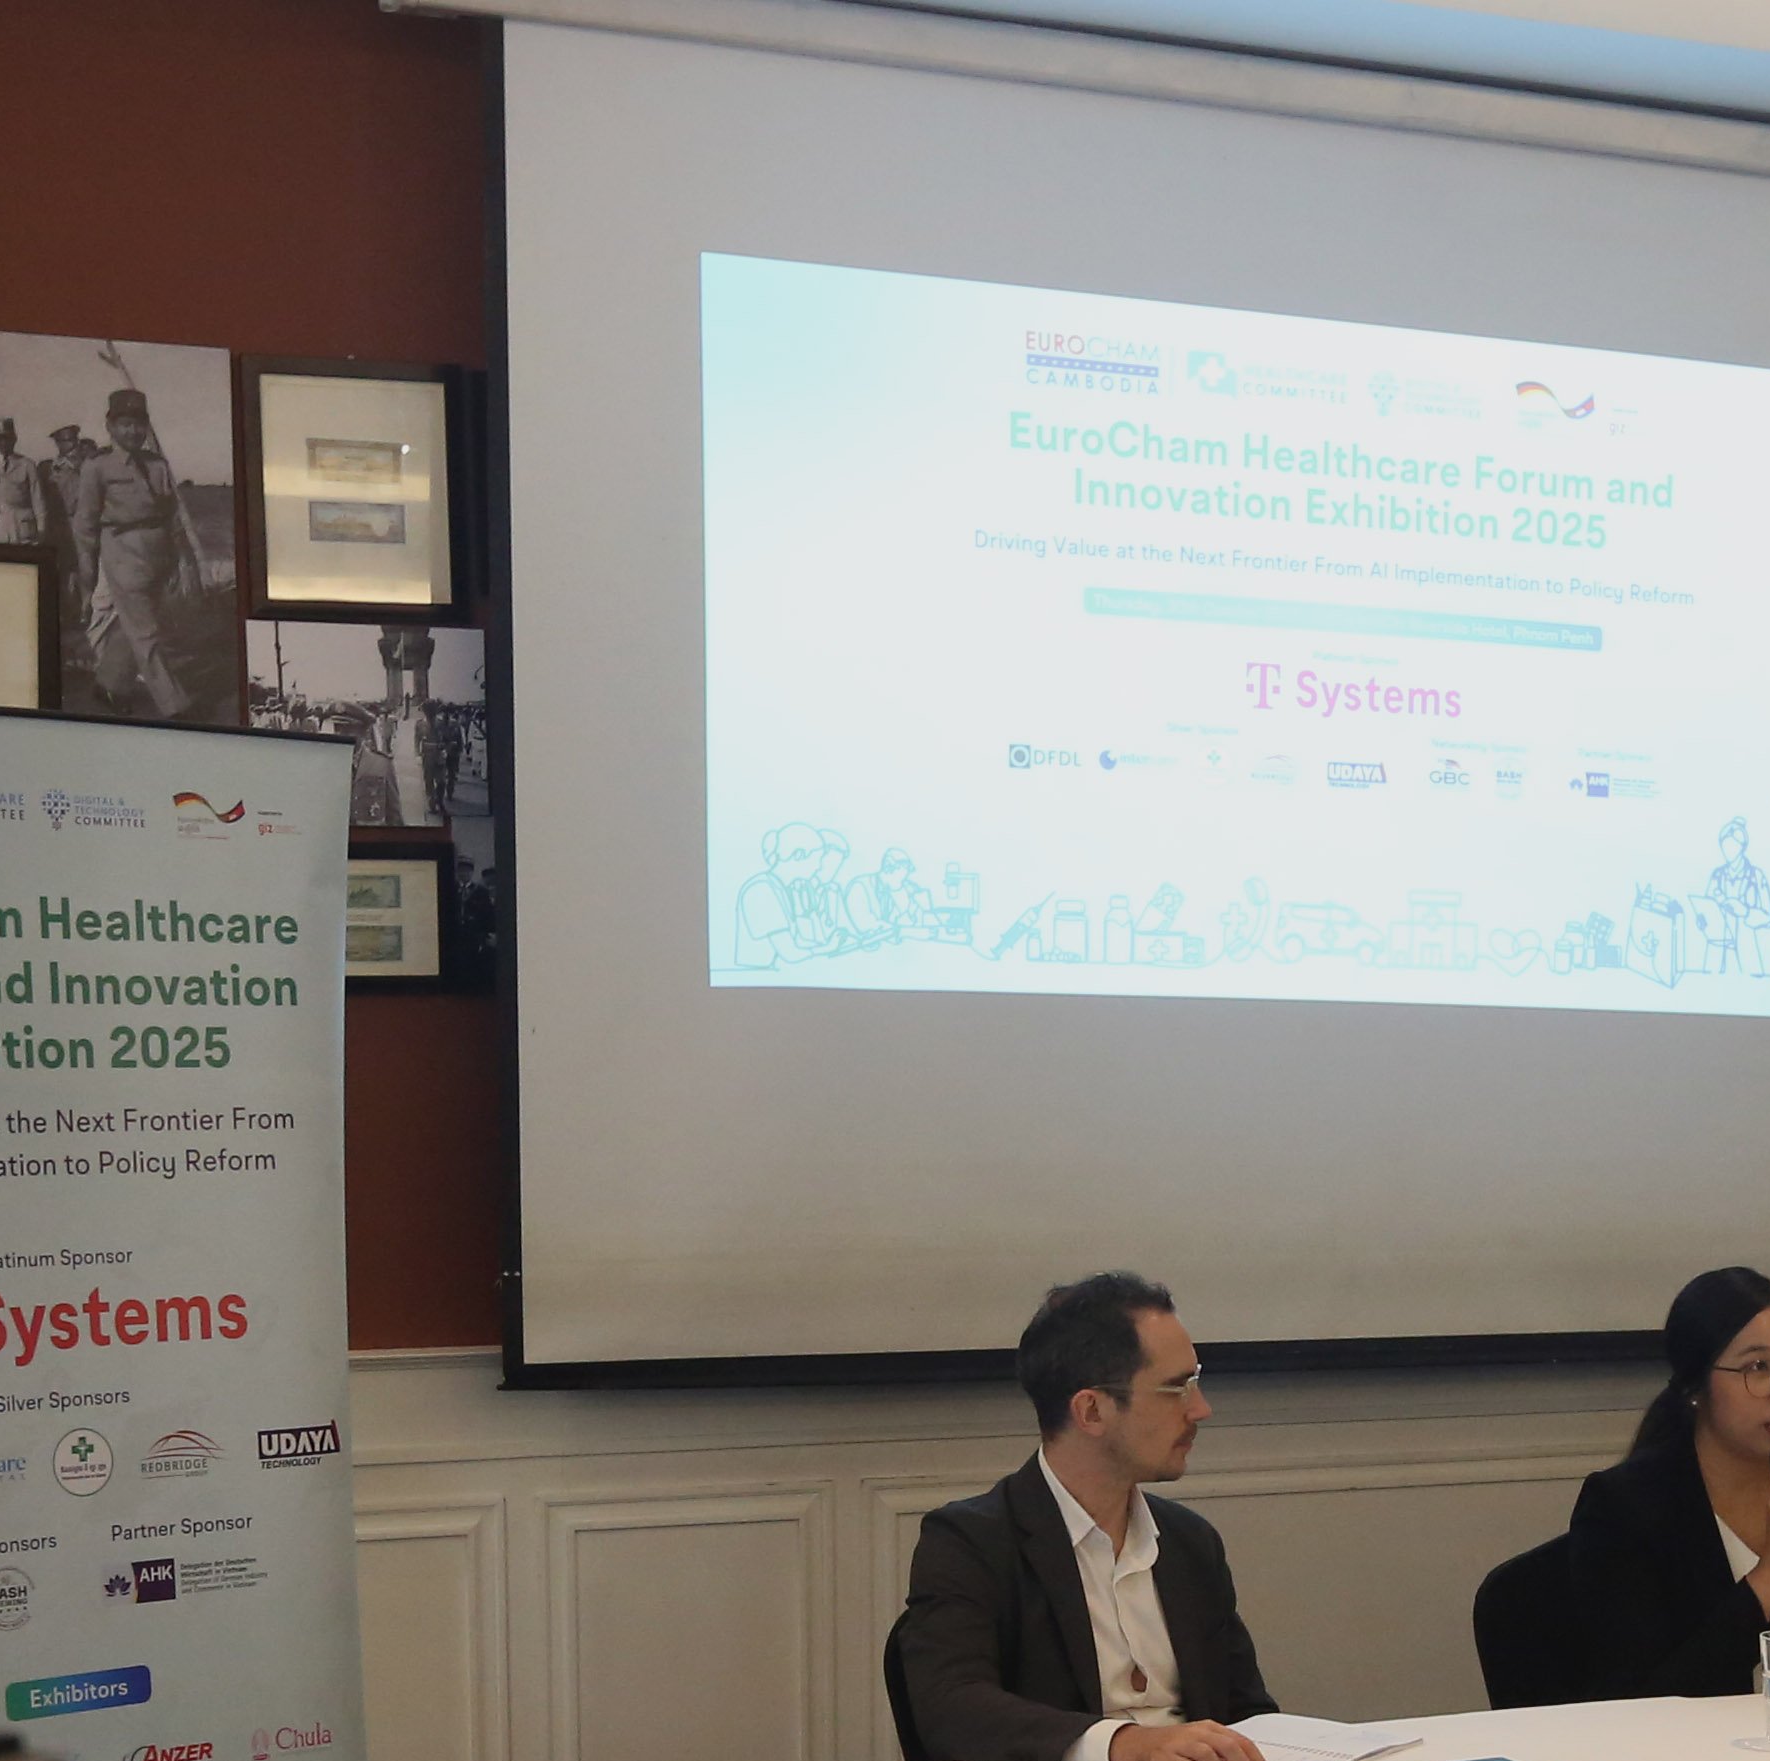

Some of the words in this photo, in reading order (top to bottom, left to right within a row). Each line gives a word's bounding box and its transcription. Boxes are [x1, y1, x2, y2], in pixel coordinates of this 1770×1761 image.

[1026, 330, 1159, 361] EUROCHAM
[1027, 368, 1158, 395] CAMBODIA
[1243, 382, 1347, 404] COMMITTEE
[1009, 411, 1228, 468] EuroCham
[1243, 433, 1460, 489] Healthcare
[1475, 456, 1592, 501] Forum
[1606, 474, 1673, 510] and
[1074, 468, 1291, 523] Innovation
[1307, 489, 1498, 542] Exhibition
[1511, 508, 1606, 550] 2025
[975, 529, 1046, 558] Driving
[1053, 536, 1110, 558] Value
[1117, 544, 1134, 560] at
[1141, 544, 1173, 563] the
[1180, 546, 1226, 567] Next
[1232, 549, 1308, 574] Frontier
[1314, 556, 1363, 577] From
[1370, 562, 1387, 579] AI
[1395, 564, 1540, 593] Implementation
[1546, 578, 1563, 595] to
[1569, 578, 1623, 604] Policy
[1630, 584, 1694, 606] Reform
[1561, 628, 1594, 646] Penh
[1295, 669, 1462, 718] Systems
[1033, 750, 1081, 768] DFDL
[1329, 763, 1383, 783] UDAYA
[1430, 770, 1470, 786] GBC
[74, 796, 114, 806] DIGITAL
[75, 806, 144, 818] TECHNOLOGY
[75, 817, 146, 829] COMMITTEE
[39, 896, 299, 944] Healthcare
[50, 961, 298, 1006] Innovation
[109, 1026, 231, 1069] 2025
[6, 1110, 47, 1134] the
[56, 1109, 115, 1133] Next
[124, 1108, 224, 1132] Frontier
[232, 1107, 294, 1130] From
[64, 1156, 90, 1177] to
[99, 1150, 175, 1179] Policy
[186, 1149, 276, 1172] Reform
[59, 1248, 133, 1271] Sponsor
[49, 1388, 131, 1413] Sponsors
[261, 1429, 336, 1456] UDAYA
[141, 1458, 208, 1473] REDBRIDGE
[260, 1457, 322, 1470] TECHNOLOGY
[111, 1522, 176, 1542] Partner
[181, 1515, 253, 1539] Sponsor
[140, 1565, 173, 1583] AHK
[30, 1680, 129, 1708] Exhibitors
[275, 1722, 333, 1750] Chula
